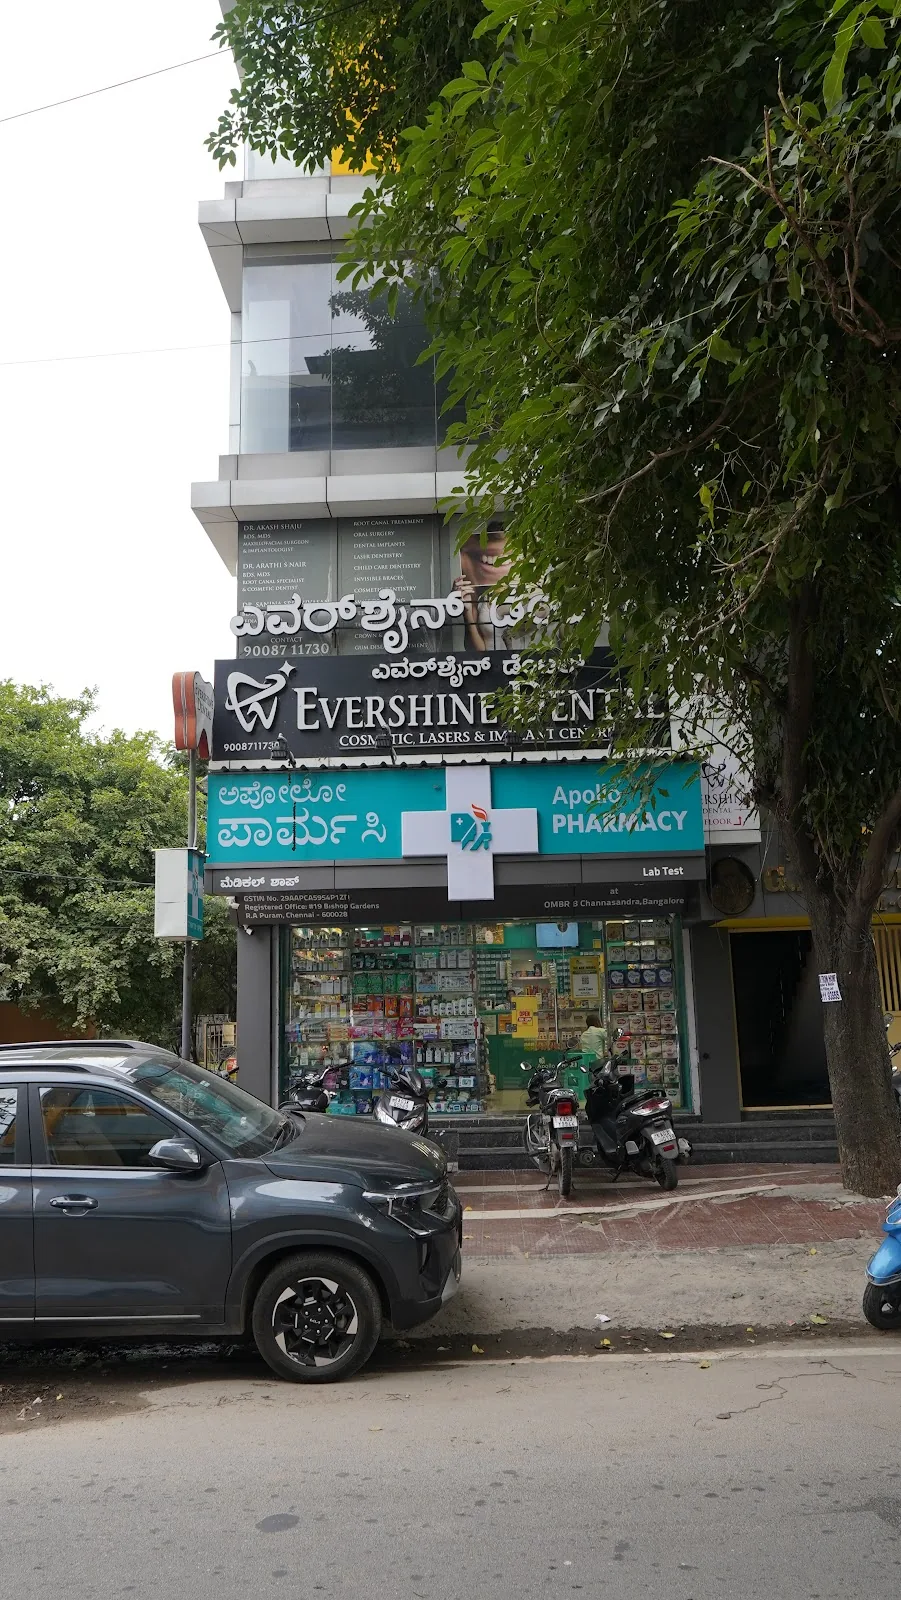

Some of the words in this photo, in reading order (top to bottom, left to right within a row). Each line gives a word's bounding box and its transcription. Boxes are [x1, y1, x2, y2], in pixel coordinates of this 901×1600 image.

[244, 645, 287, 656] 90087
[291, 643, 330, 655] 11730
[292, 687, 498, 730] EVERSHINE
[339, 733, 415, 746] COSMTIC,
[419, 731, 470, 744] LASERS
[474, 731, 485, 742] &
[559, 726, 613, 739] CENR
[218, 778, 346, 809] ಅಪೋಲೋ
[552, 784, 621, 809] Apollo
[552, 811, 688, 833] PHARMACY
[643, 867, 660, 877] Lab
[662, 866, 684, 875] Test
[220, 876, 265, 888] ಮೆಡಿಕಲ್
[270, 876, 299, 886] ಶಾಪ್
[244, 904, 282, 912] Registered
